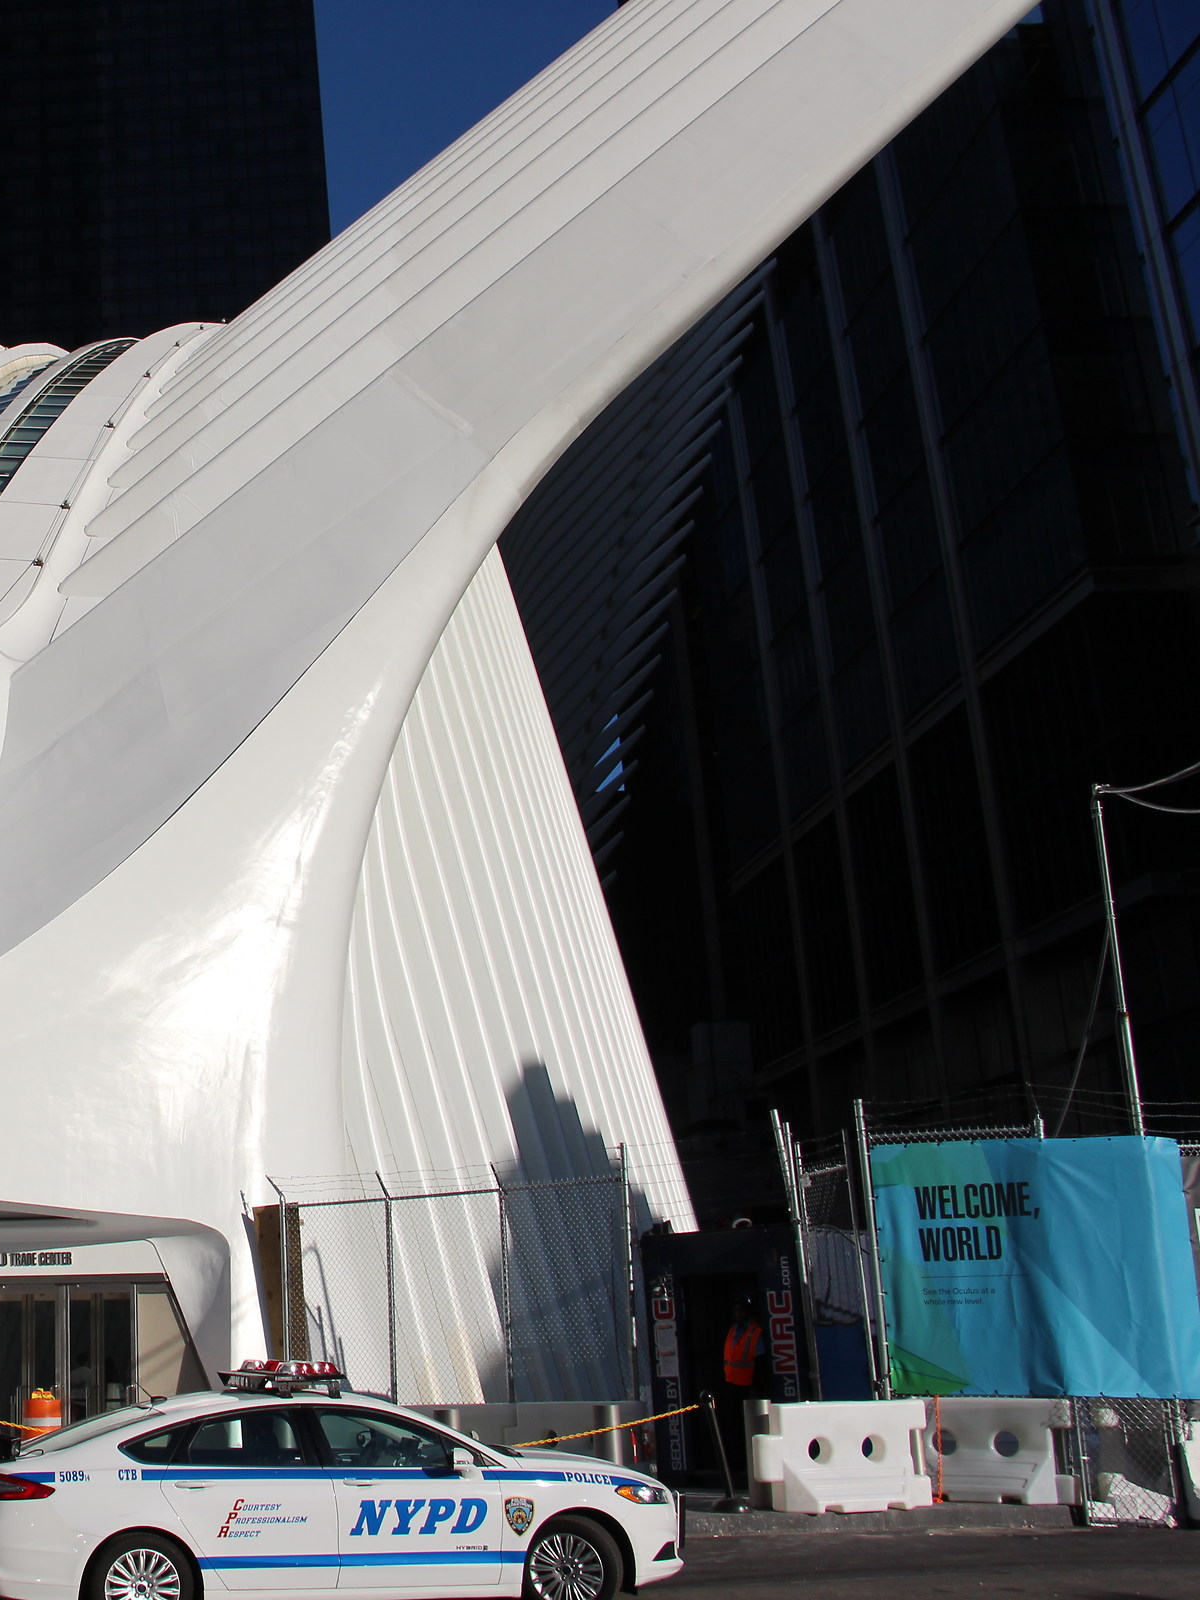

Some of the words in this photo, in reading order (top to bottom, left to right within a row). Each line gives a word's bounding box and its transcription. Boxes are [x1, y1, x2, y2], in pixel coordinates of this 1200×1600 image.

[914, 1182, 1040, 1219] WELCOME,
[918, 1225, 1002, 1262] WORLD
[8, 1252, 38, 1266] TRADE
[38, 1251, 73, 1266] CENTER
[953, 1287, 979, 1295] Oculus
[666, 1379, 677, 1399] BY
[784, 1376, 796, 1397] BY
[59, 1470, 85, 1483] 5089
[118, 1469, 138, 1481] CTB
[565, 1472, 612, 1485] POLICE
[233, 1499, 281, 1511] COURTESY
[225, 1512, 308, 1525] PROFESSIONALISM
[349, 1497, 488, 1536] NYPD
[217, 1525, 261, 1538] RESPECT
